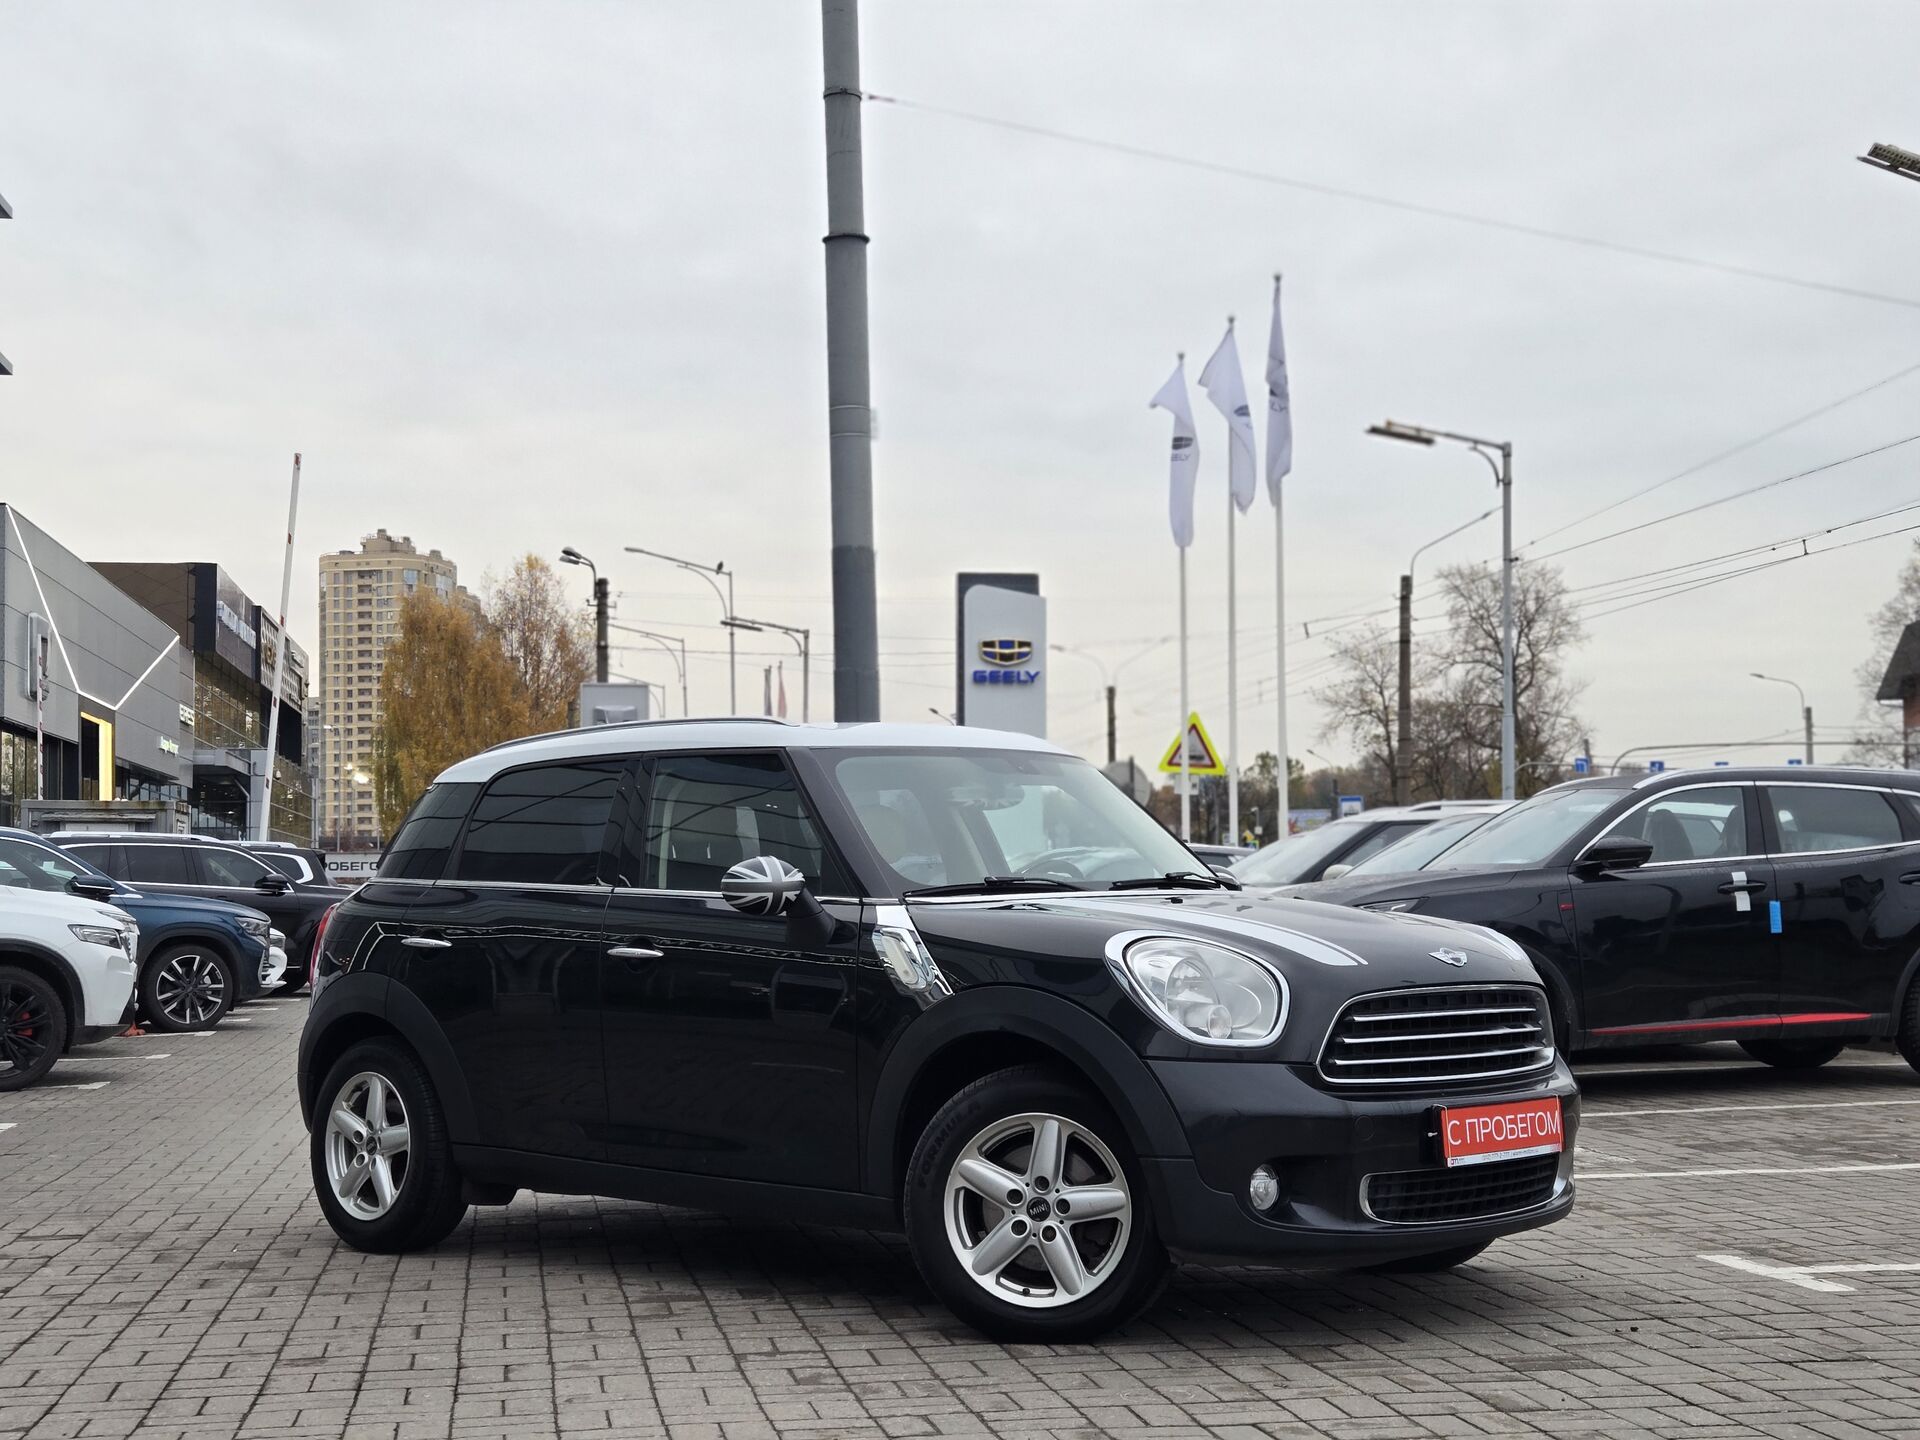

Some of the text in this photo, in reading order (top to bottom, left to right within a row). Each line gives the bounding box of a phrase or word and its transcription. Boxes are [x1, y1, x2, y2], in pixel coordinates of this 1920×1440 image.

[972, 669, 1040, 685] GEELY
[1448, 1109, 1560, 1146] С ПРОБЕГОМ
[1029, 1203, 1048, 1216] MINI
